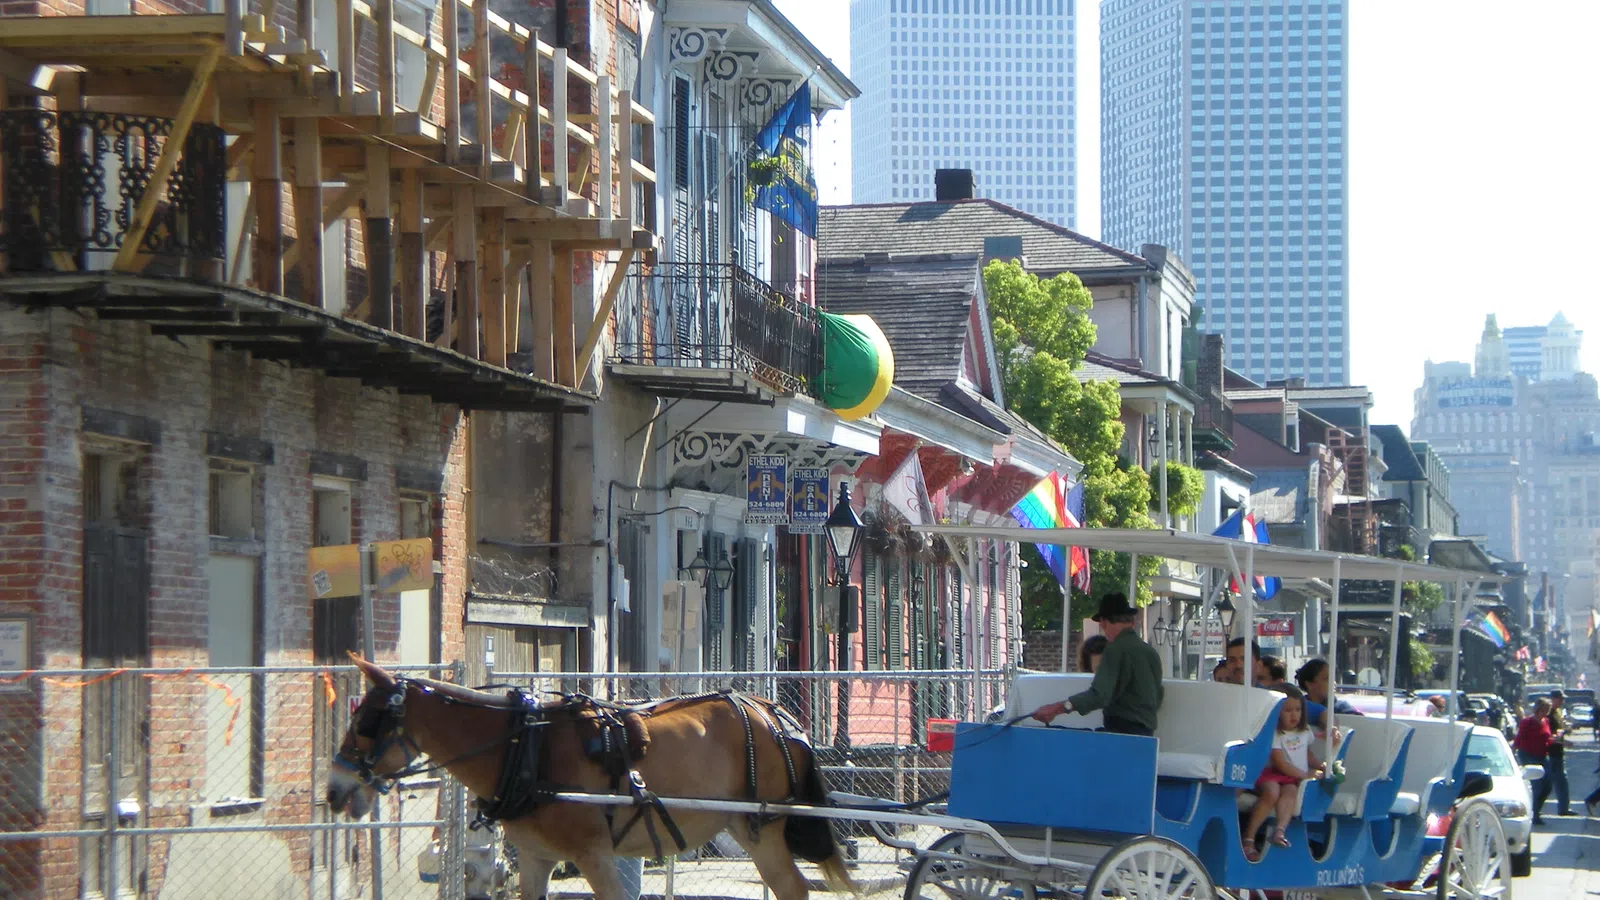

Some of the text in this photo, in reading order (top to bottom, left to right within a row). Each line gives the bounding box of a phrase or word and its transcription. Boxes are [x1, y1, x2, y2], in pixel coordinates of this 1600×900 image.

[749, 457, 785, 466] ETHEL KIDD
[794, 470, 828, 479] ETHEL KIDD
[762, 473, 771, 501] RENT
[806, 485, 815, 511] SALE
